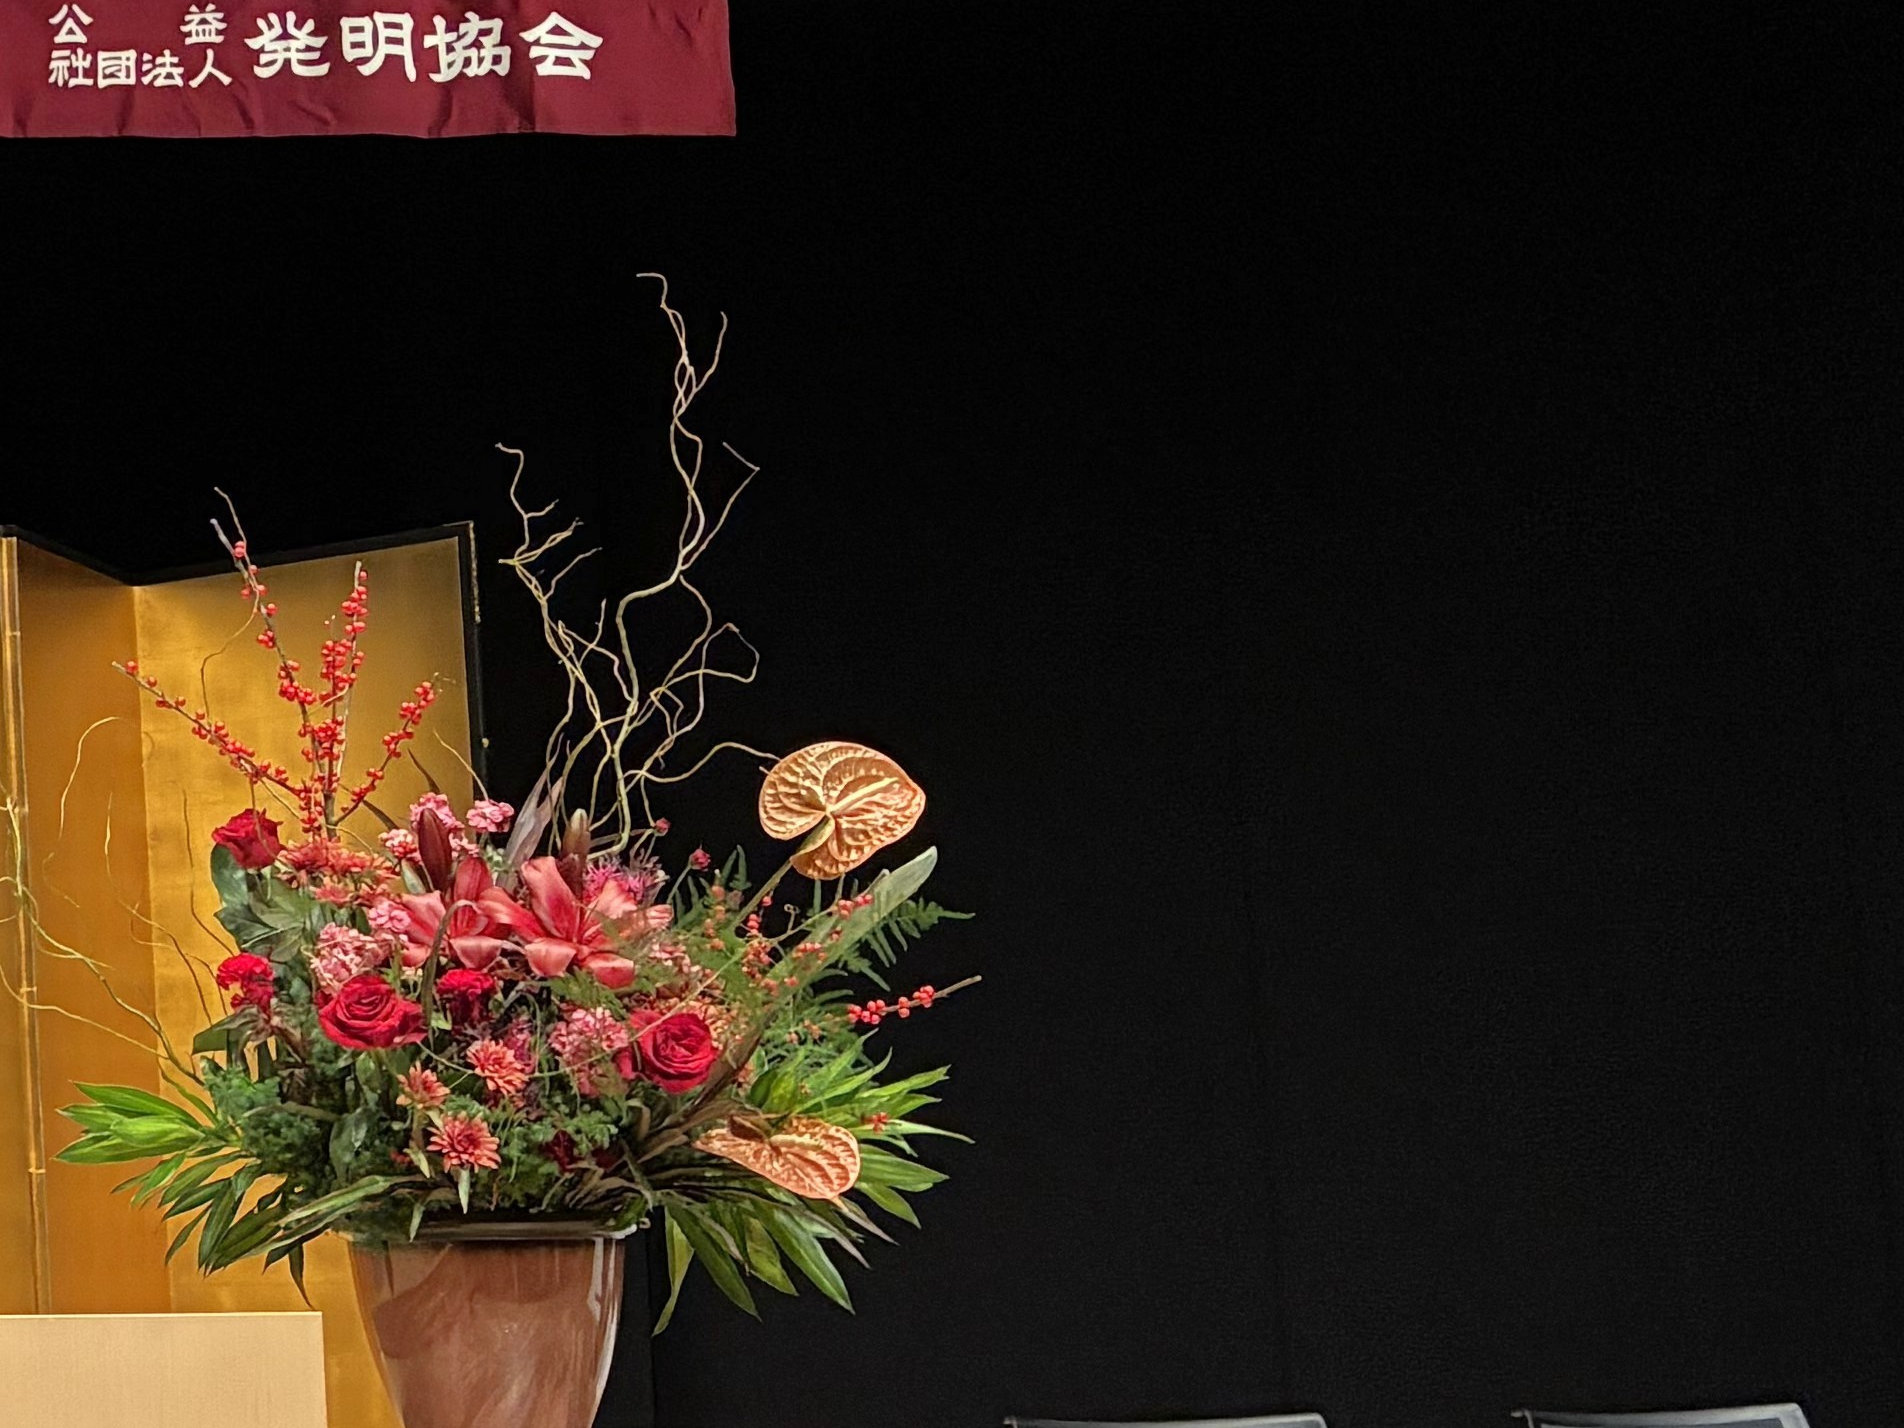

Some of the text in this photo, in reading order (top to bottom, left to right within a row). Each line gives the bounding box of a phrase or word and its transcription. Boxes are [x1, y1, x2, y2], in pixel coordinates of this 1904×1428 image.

[48, 3, 229, 46] 公益
[244, 10, 605, 83] 発明協会
[48, 48, 234, 89] 社団法人
